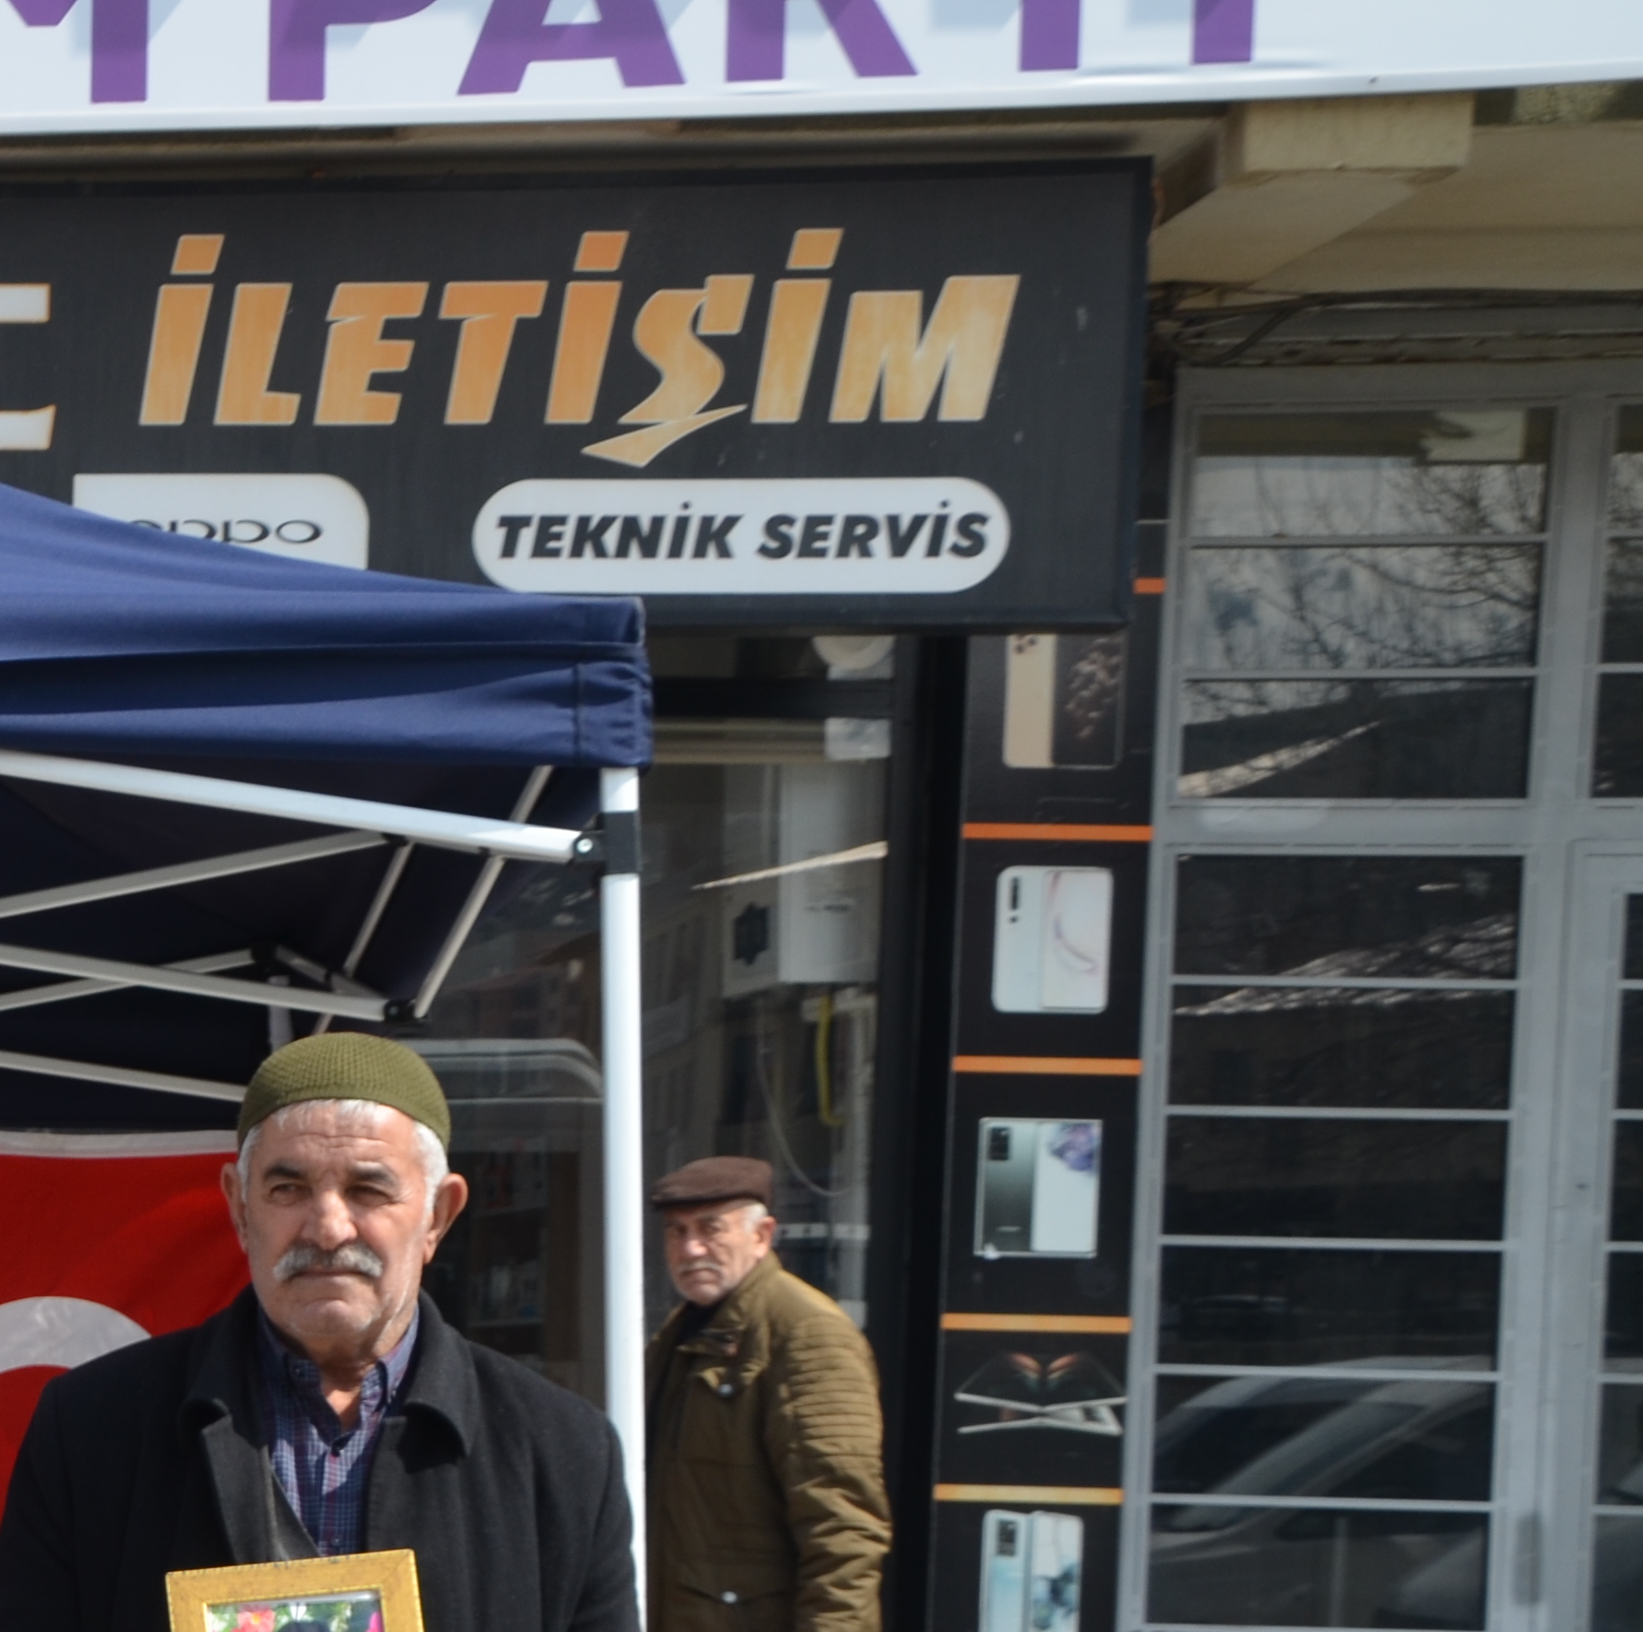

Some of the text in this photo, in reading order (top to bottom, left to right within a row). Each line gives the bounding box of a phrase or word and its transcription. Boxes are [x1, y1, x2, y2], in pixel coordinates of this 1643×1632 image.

[139, 228, 1022, 468] İLETİŞİM
[498, 499, 991, 560] TEKNİK SERVİS
